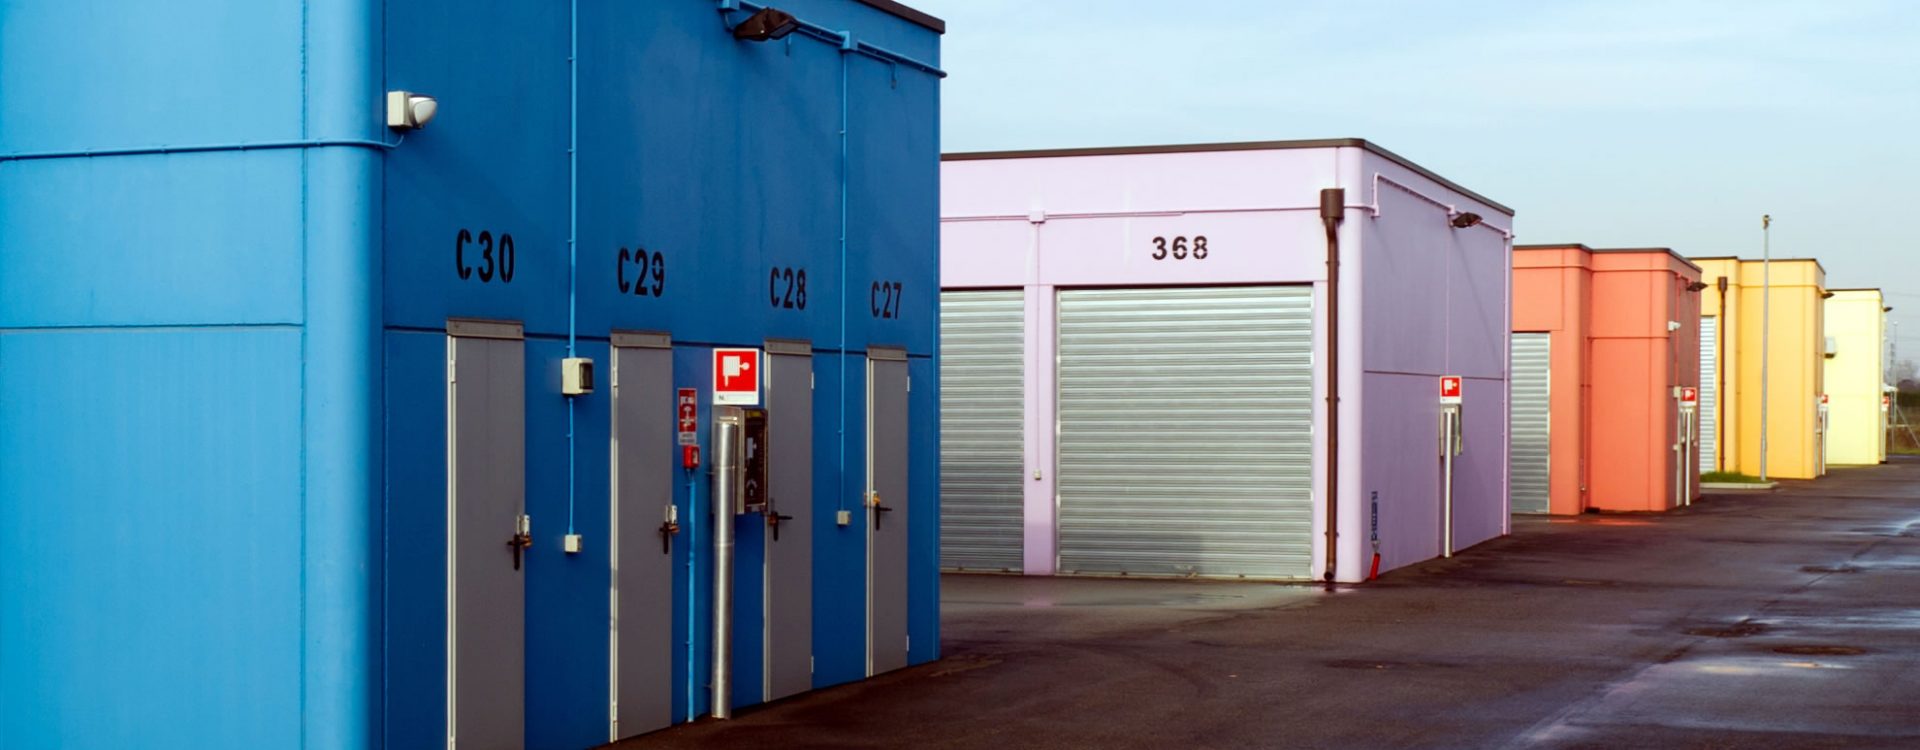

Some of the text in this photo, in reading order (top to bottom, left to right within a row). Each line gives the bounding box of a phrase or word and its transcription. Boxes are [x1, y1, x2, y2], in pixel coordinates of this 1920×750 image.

[456, 228, 515, 284] C30
[1151, 236, 1209, 261] 368
[617, 247, 665, 298] C29
[770, 267, 807, 310] C28
[871, 281, 902, 319] C27
